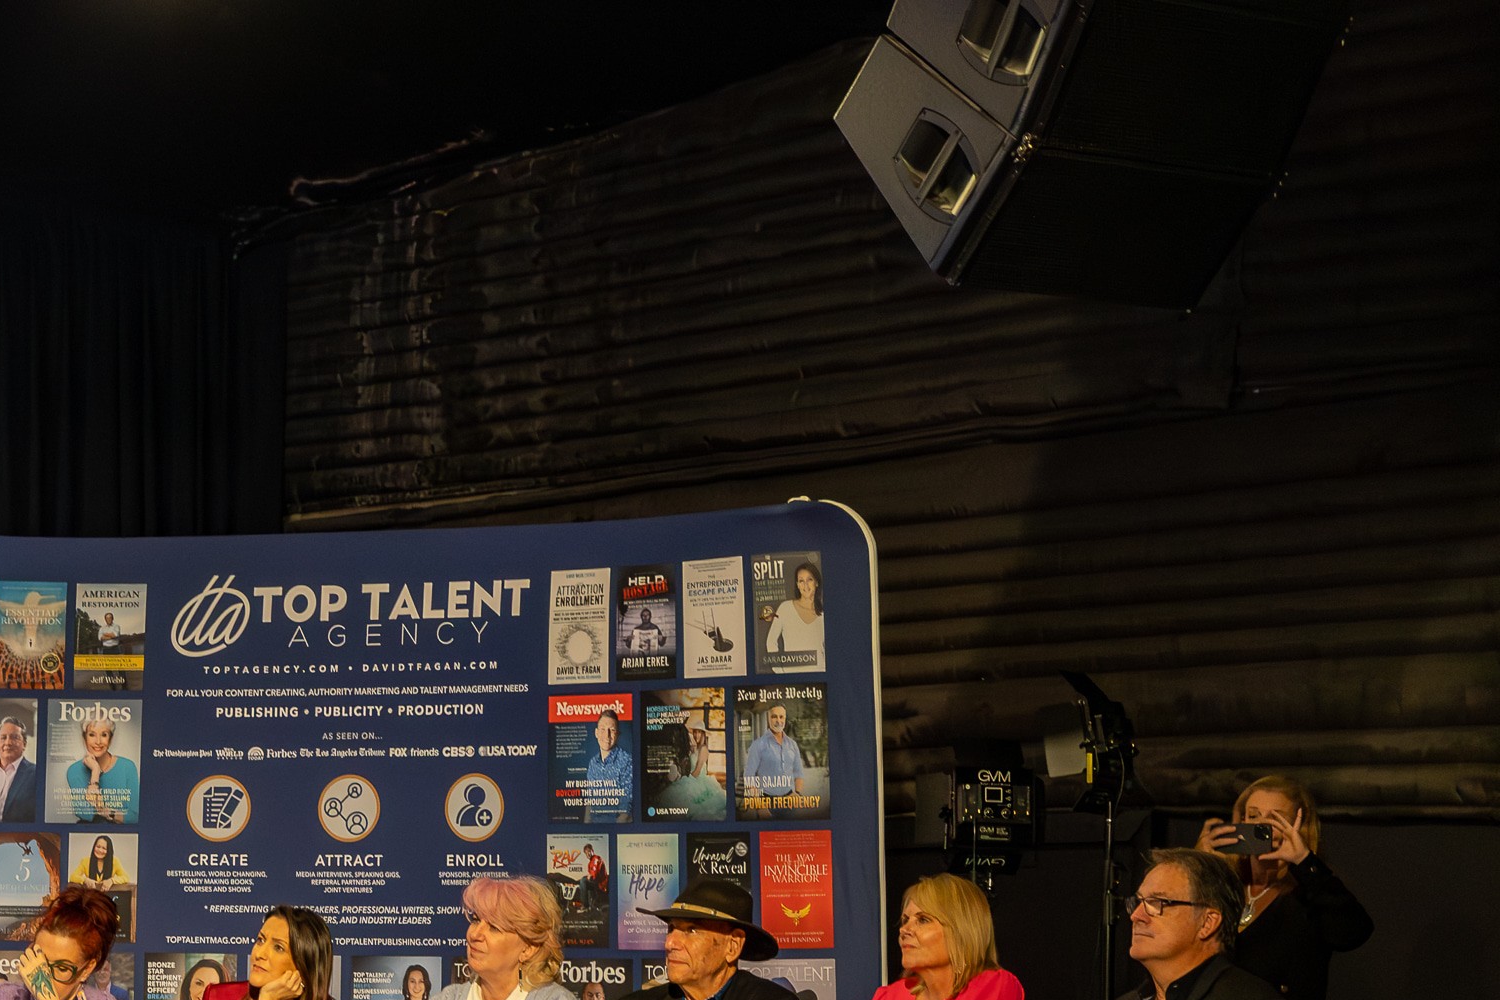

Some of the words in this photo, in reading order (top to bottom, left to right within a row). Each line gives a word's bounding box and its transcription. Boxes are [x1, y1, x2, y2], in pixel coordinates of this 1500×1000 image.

[753, 560, 785, 580] SPLIT
[628, 574, 665, 586] HELD
[686, 579, 739, 590] ENTREPRENEUR
[82, 590, 140, 599] AMERICAN
[556, 584, 604, 596] ATTRACTION
[688, 587, 716, 597] ESCAPE
[253, 583, 348, 623] TOP
[361, 578, 531, 621] TALENT
[555, 595, 604, 607] ENROLLMENT
[1, 617, 62, 625] REVOLUTION
[288, 621, 489, 648] AGENCY
[203, 664, 339, 675] TOPTAGENCY.COM
[362, 661, 498, 672] DAVIDTFAGAN.COM
[646, 656, 670, 668] ERKEL
[166, 688, 184, 697] FOR
[184, 688, 199, 697] ALL
[200, 688, 224, 697] YOUR
[224, 688, 264, 697] CONTENT
[265, 687, 307, 698] CREATING,
[308, 687, 353, 696] AUTHORITY
[354, 686, 400, 696] MARKETING
[401, 686, 419, 695] AND
[419, 685, 448, 694] TALENT
[448, 684, 503, 694] MANAGEMENT
[503, 683, 529, 693] NEEDS
[737, 689, 757, 701] New
[759, 688, 783, 702] York
[785, 686, 823, 700] Weekly
[58, 701, 132, 722] Forbes
[216, 706, 299, 718] PUBLISHING
[314, 705, 383, 717] PUBLICITY
[397, 703, 484, 716] PRODUCTION
[556, 700, 625, 716] Newsweek
[322, 732, 333, 740] AS
[336, 732, 359, 740] SEEN
[266, 748, 297, 759] Forbes
[359, 747, 386, 757] Tribune
[389, 747, 408, 757] FOX
[410, 746, 439, 757] friends
[507, 744, 538, 757] TODAY
[743, 776, 760, 788] MAS
[762, 775, 792, 788] SAJADY
[977, 769, 1011, 782] GVM
[575, 780, 603, 788] BUSINESS
[563, 798, 583, 806] YOURS
[583, 798, 607, 806] SHOULD
[744, 797, 772, 809] POWER
[773, 795, 820, 809] FREQUENCY
[188, 853, 249, 866] CREATE
[314, 854, 384, 867] ATTRACT
[446, 853, 504, 867] ENROLL
[15, 858, 31, 882] 5
[166, 870, 208, 878] BESTSELLING,
[208, 870, 231, 878] WORLD
[232, 870, 268, 879] CHANGING,
[621, 864, 674, 874] RESURRECTING
[710, 861, 747, 875] Reveal
[764, 864, 828, 877] INVINCIBLE
[179, 878, 204, 886] MONEY
[204, 878, 230, 886] MAKING
[628, 868, 666, 900] Hope
[771, 874, 821, 883] WARRIOR
[209, 905, 268, 914] REPRESENTING
[341, 905, 399, 914] PROFESSIONAL
[400, 906, 435, 915] WRITERS,
[436, 906, 461, 915] SHOW
[339, 916, 358, 924] AND
[359, 916, 398, 925] INDUSTRY
[398, 917, 431, 925] LEADERS
[165, 935, 250, 945] TOPTALENTMAG.COM
[335, 937, 441, 946] TOPTALENTPUBLISHING.COM
[560, 960, 626, 984] Forbes
[776, 966, 833, 982] TALENT
